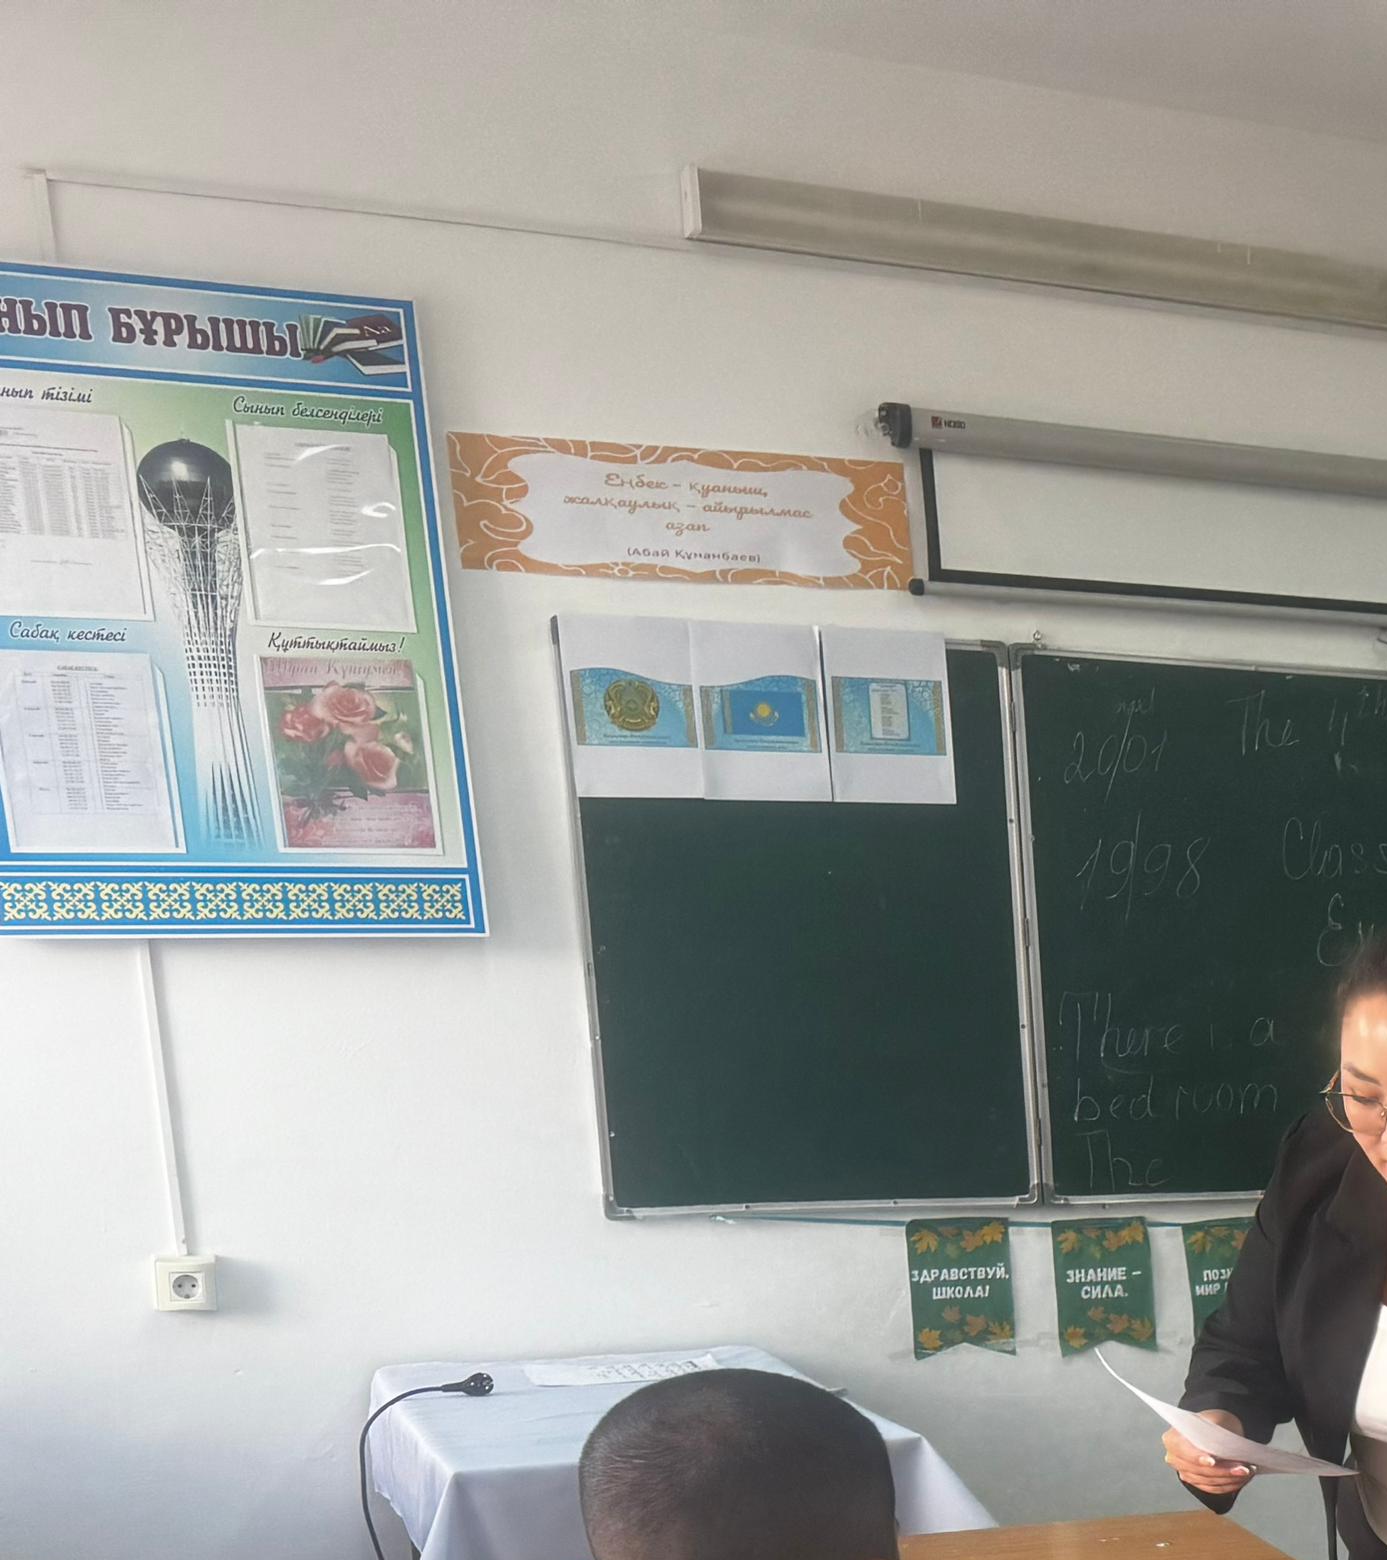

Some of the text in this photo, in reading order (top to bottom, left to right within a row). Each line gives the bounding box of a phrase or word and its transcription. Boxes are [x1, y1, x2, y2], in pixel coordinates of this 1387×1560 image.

[108, 306, 302, 359] БҰРЫШЫ
[41, 386, 94, 403] тізімі
[233, 395, 384, 426] Сынып белсенділері
[604, 473, 669, 492] Еңбек
[563, 494, 680, 514] жалқаулық
[703, 502, 813, 520] айырылмас
[665, 521, 711, 536] азап
[9, 621, 128, 644] Сабақ кестесі
[268, 631, 407, 654] Құттықтаймыз!
[1226, 689, 1302, 757] The
[1059, 991, 1185, 1060] There
[1072, 1129, 1172, 1193] The
[1066, 1267, 1127, 1283] ЗНАНИЕ
[932, 1285, 990, 1300] ШКОЛА!
[1081, 1284, 1129, 1299] СИЛА.
[1195, 1282, 1221, 1296] МИР
